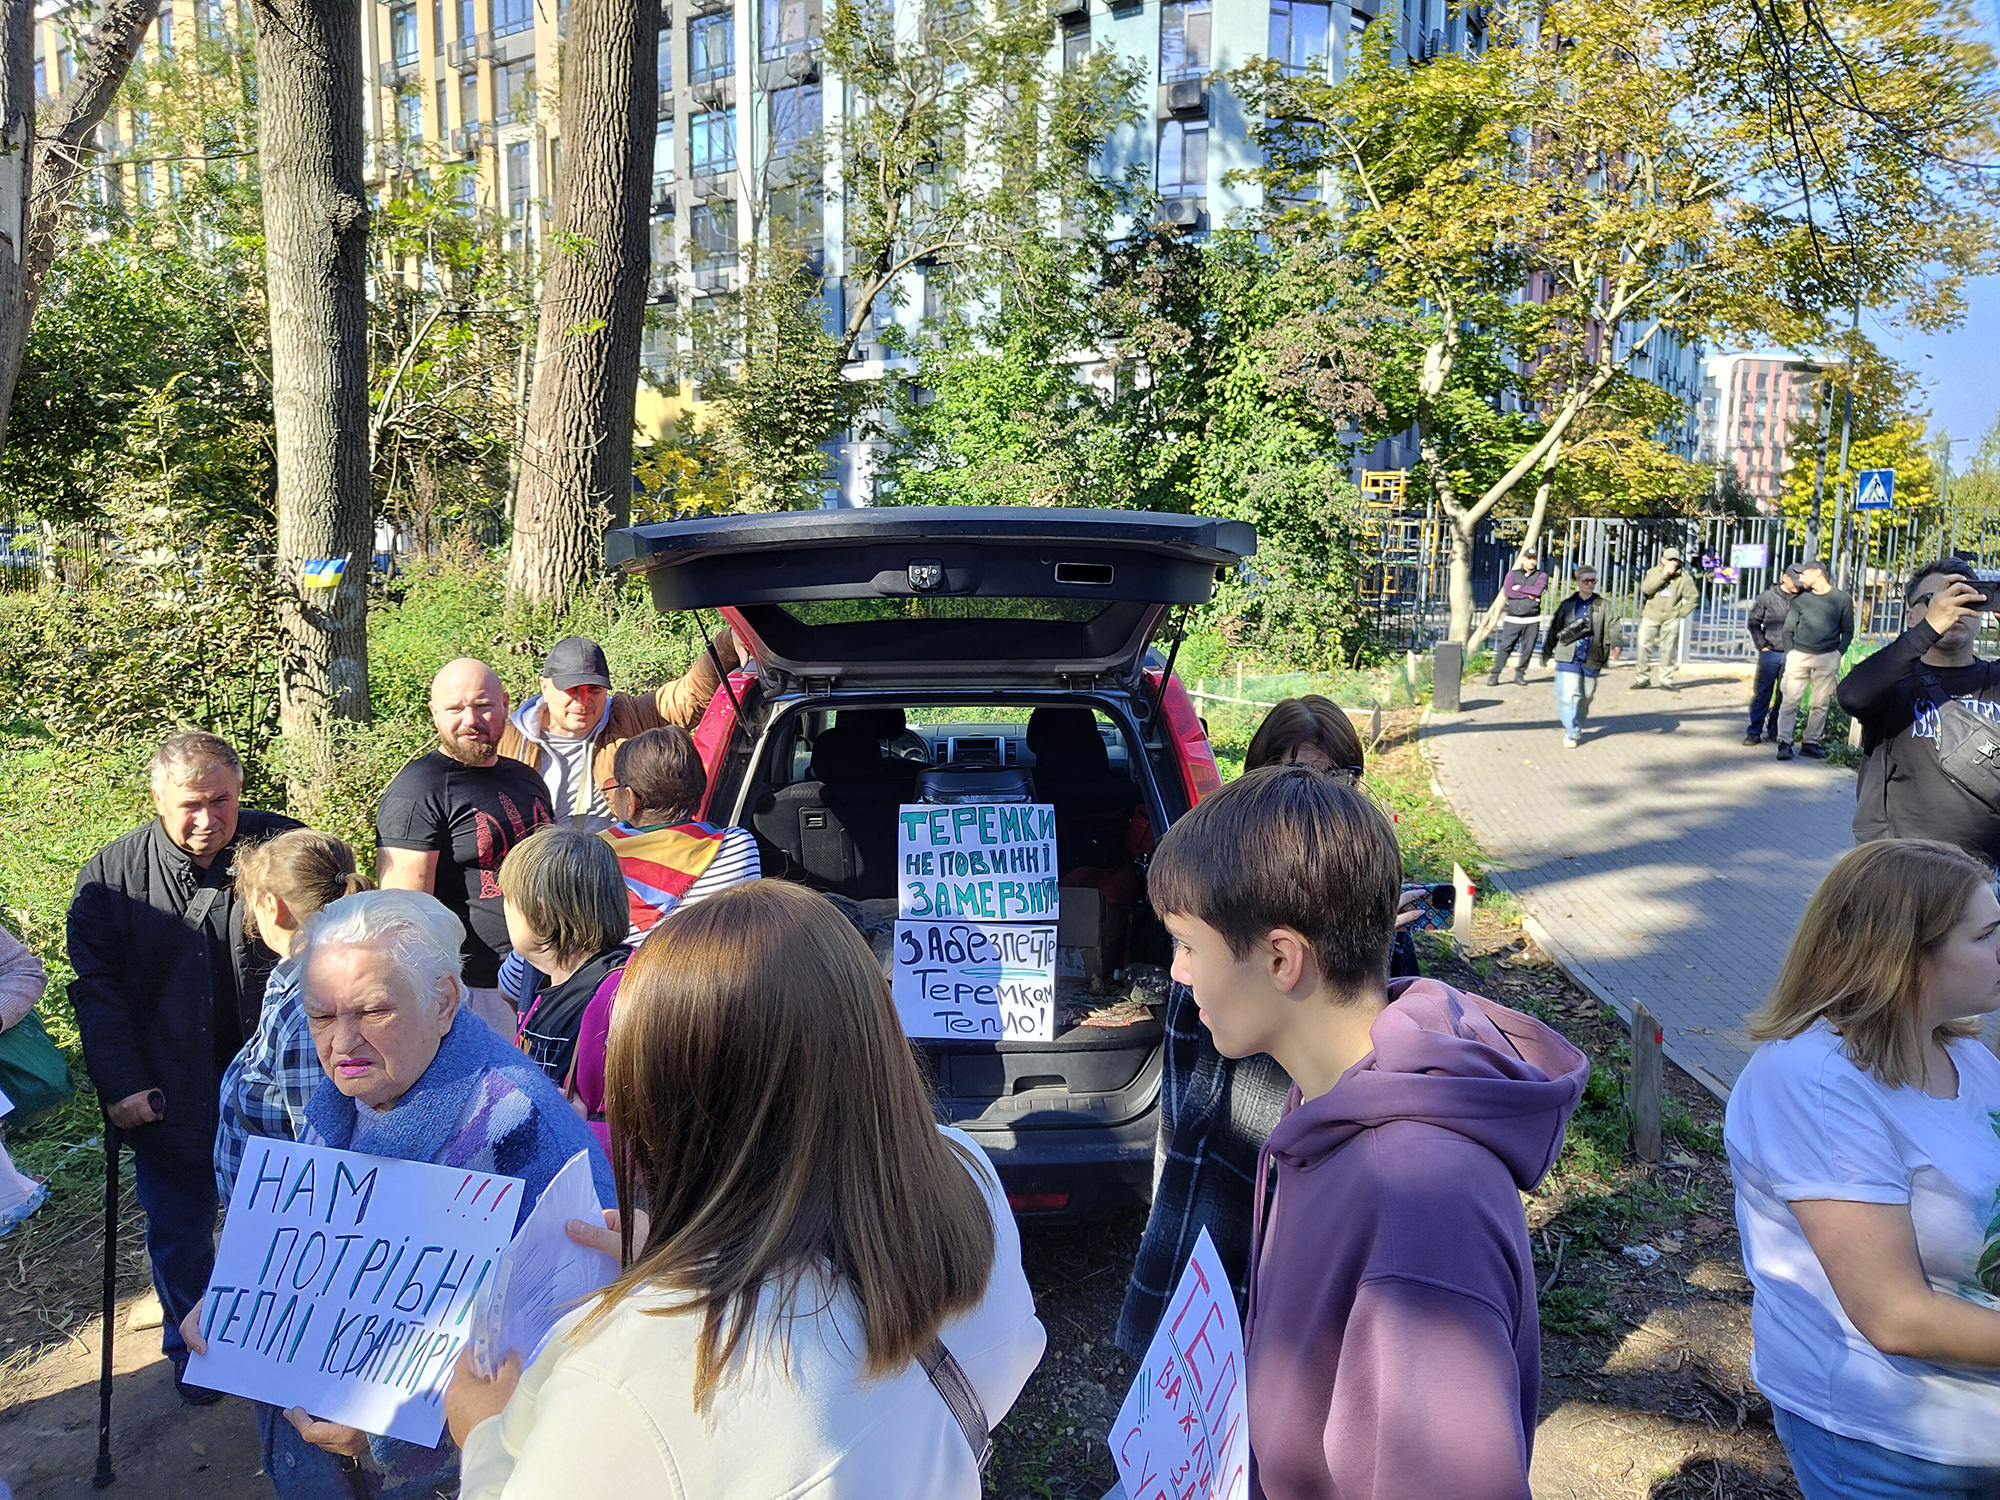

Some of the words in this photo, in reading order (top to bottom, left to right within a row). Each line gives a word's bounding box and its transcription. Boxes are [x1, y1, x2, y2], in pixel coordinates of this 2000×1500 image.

[900, 806, 1055, 846] ТЕРЕМКИ
[906, 851, 935, 876] НЕ
[939, 843, 1051, 878] ПОВИННІ
[247, 1148, 379, 1226] НАМ
[257, 1226, 501, 1326] ПОТРІБНІ
[210, 1285, 323, 1364] ТЕПЛІ
[1155, 1355, 1214, 1500] ВАЖЛИ
